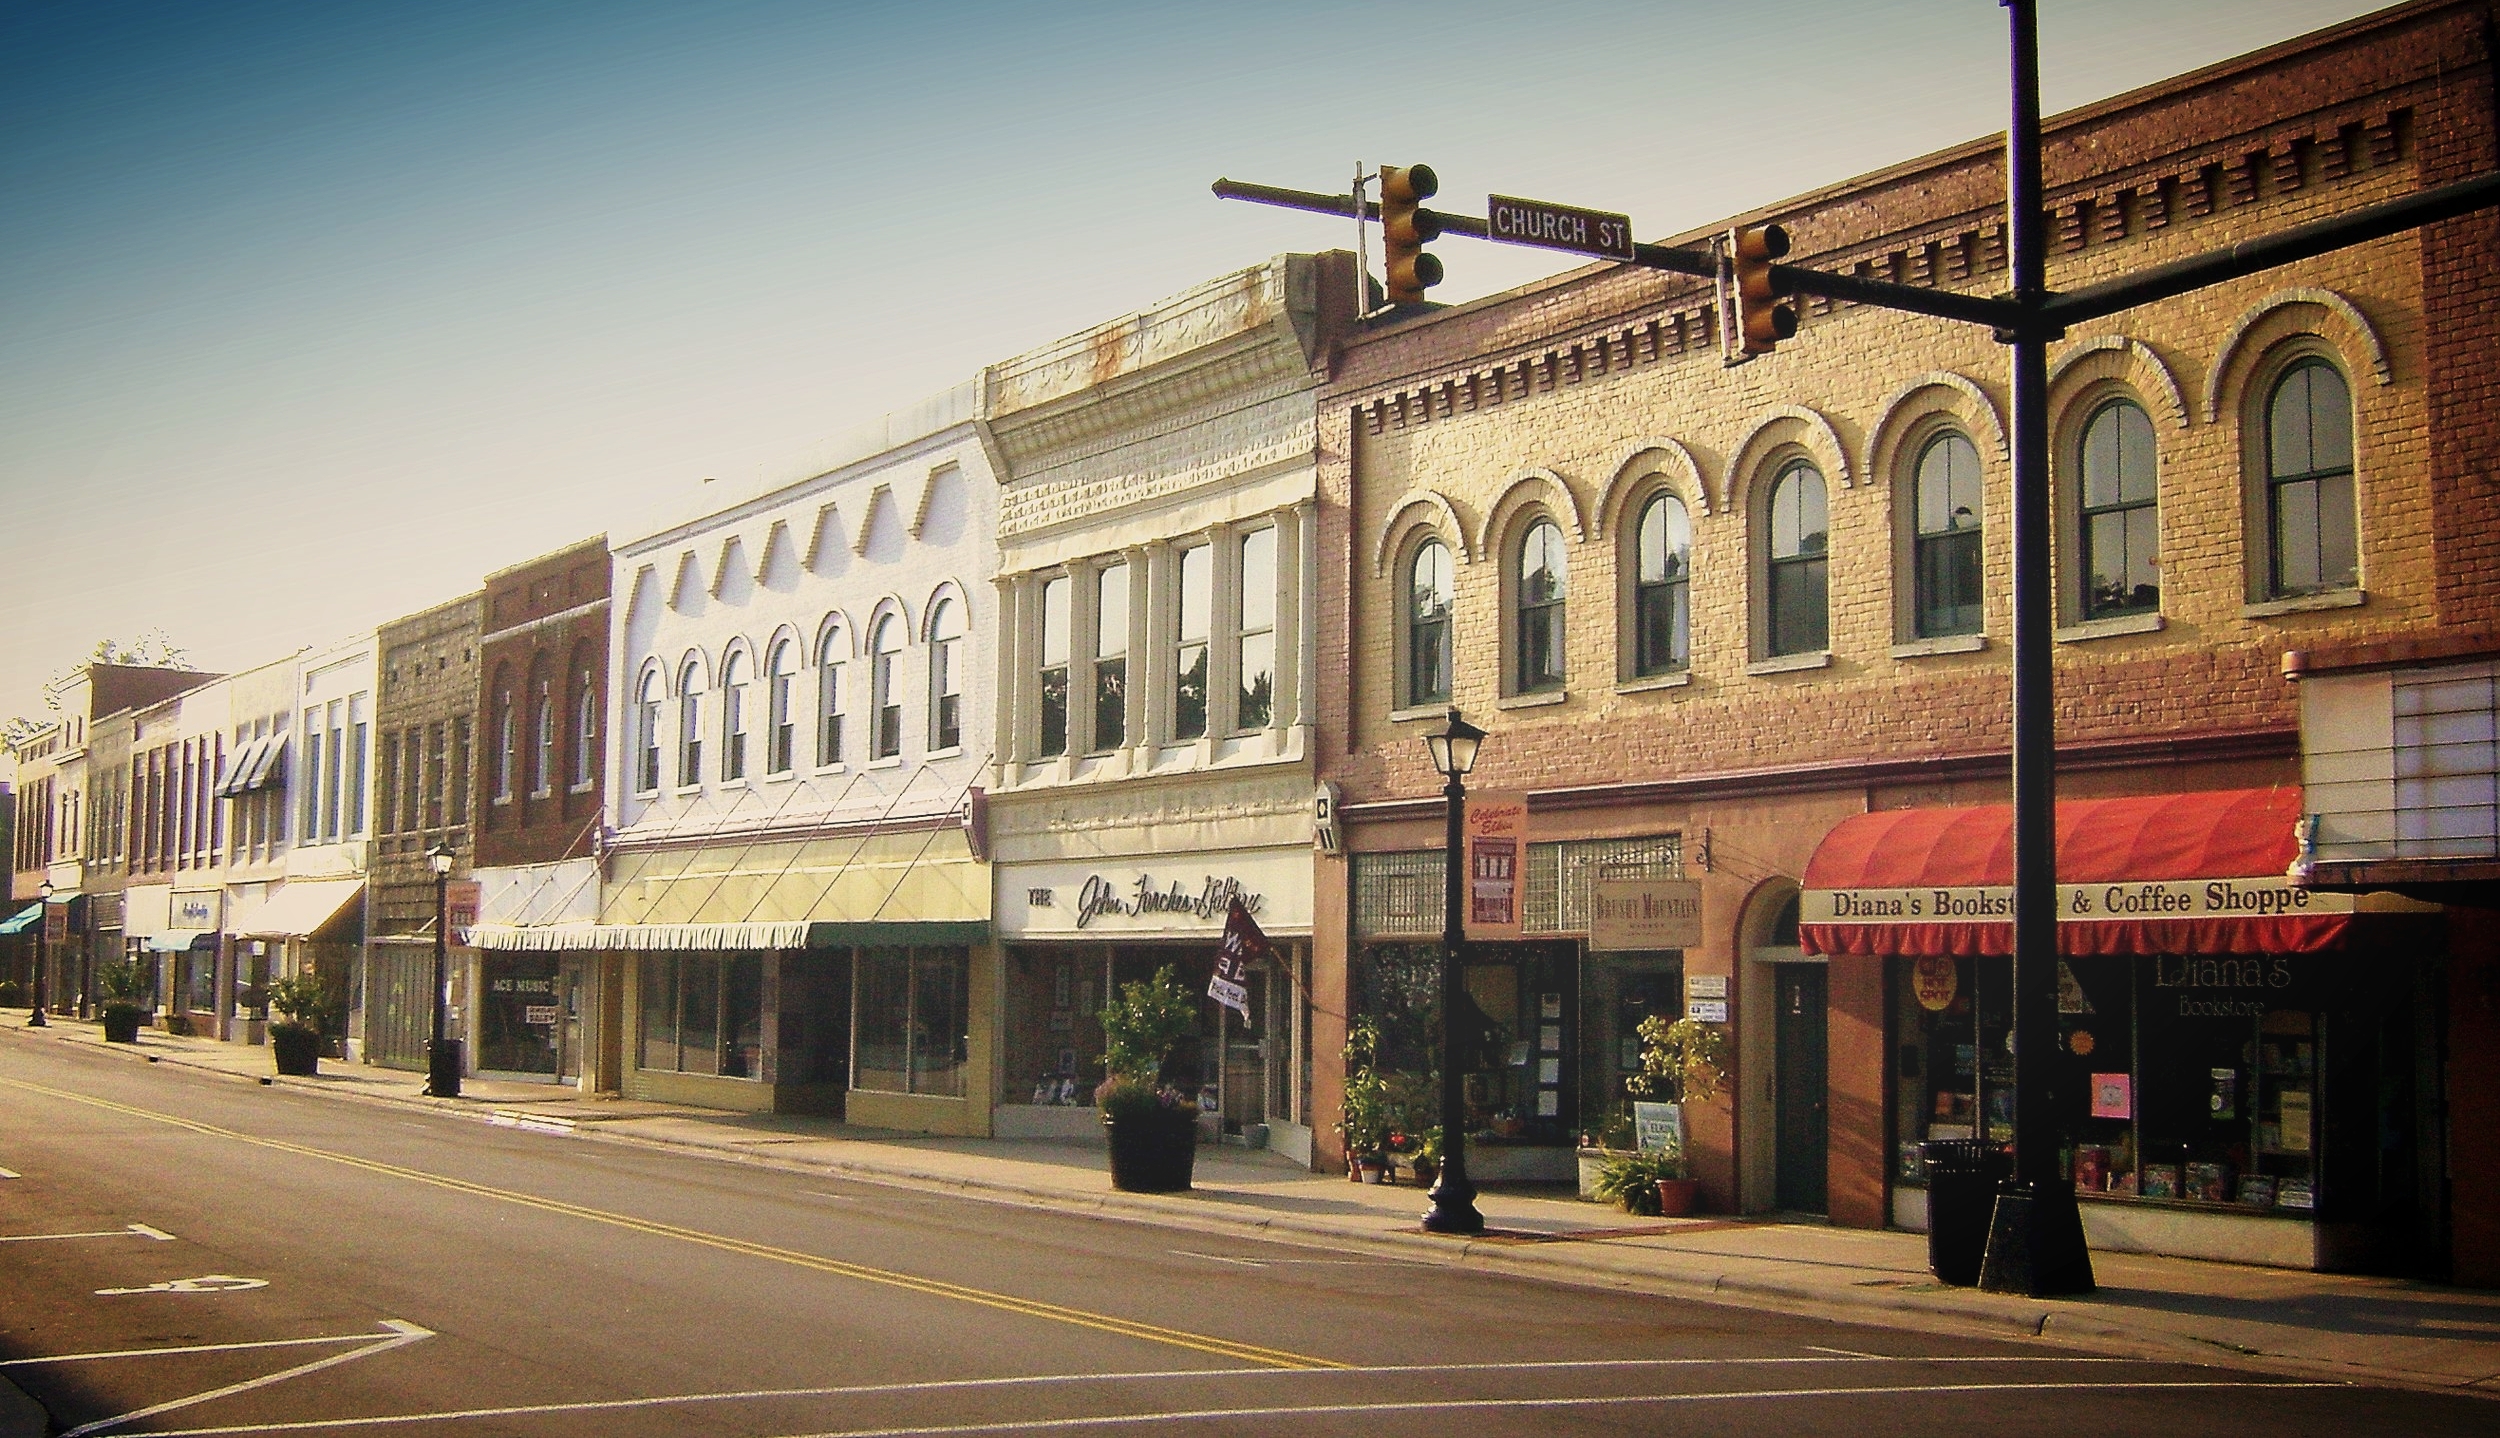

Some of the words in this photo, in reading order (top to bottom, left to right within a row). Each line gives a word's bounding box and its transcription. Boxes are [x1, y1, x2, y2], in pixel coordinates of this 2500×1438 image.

[1496, 206, 1586, 244] CHURCH
[1599, 221, 1624, 249] ST
[1470, 806, 1522, 825] Celebrate
[1027, 888, 1053, 906] THE
[1076, 873, 1122, 929] John
[1193, 875, 1262, 920] Gallry
[1832, 891, 1922, 917] Diana's
[1932, 889, 2016, 916] Bookst
[2071, 889, 2092, 914] &
[2104, 885, 2192, 914] Coffee
[2205, 881, 2310, 915] Shoppe
[2179, 994, 2265, 1017] Bookstore
